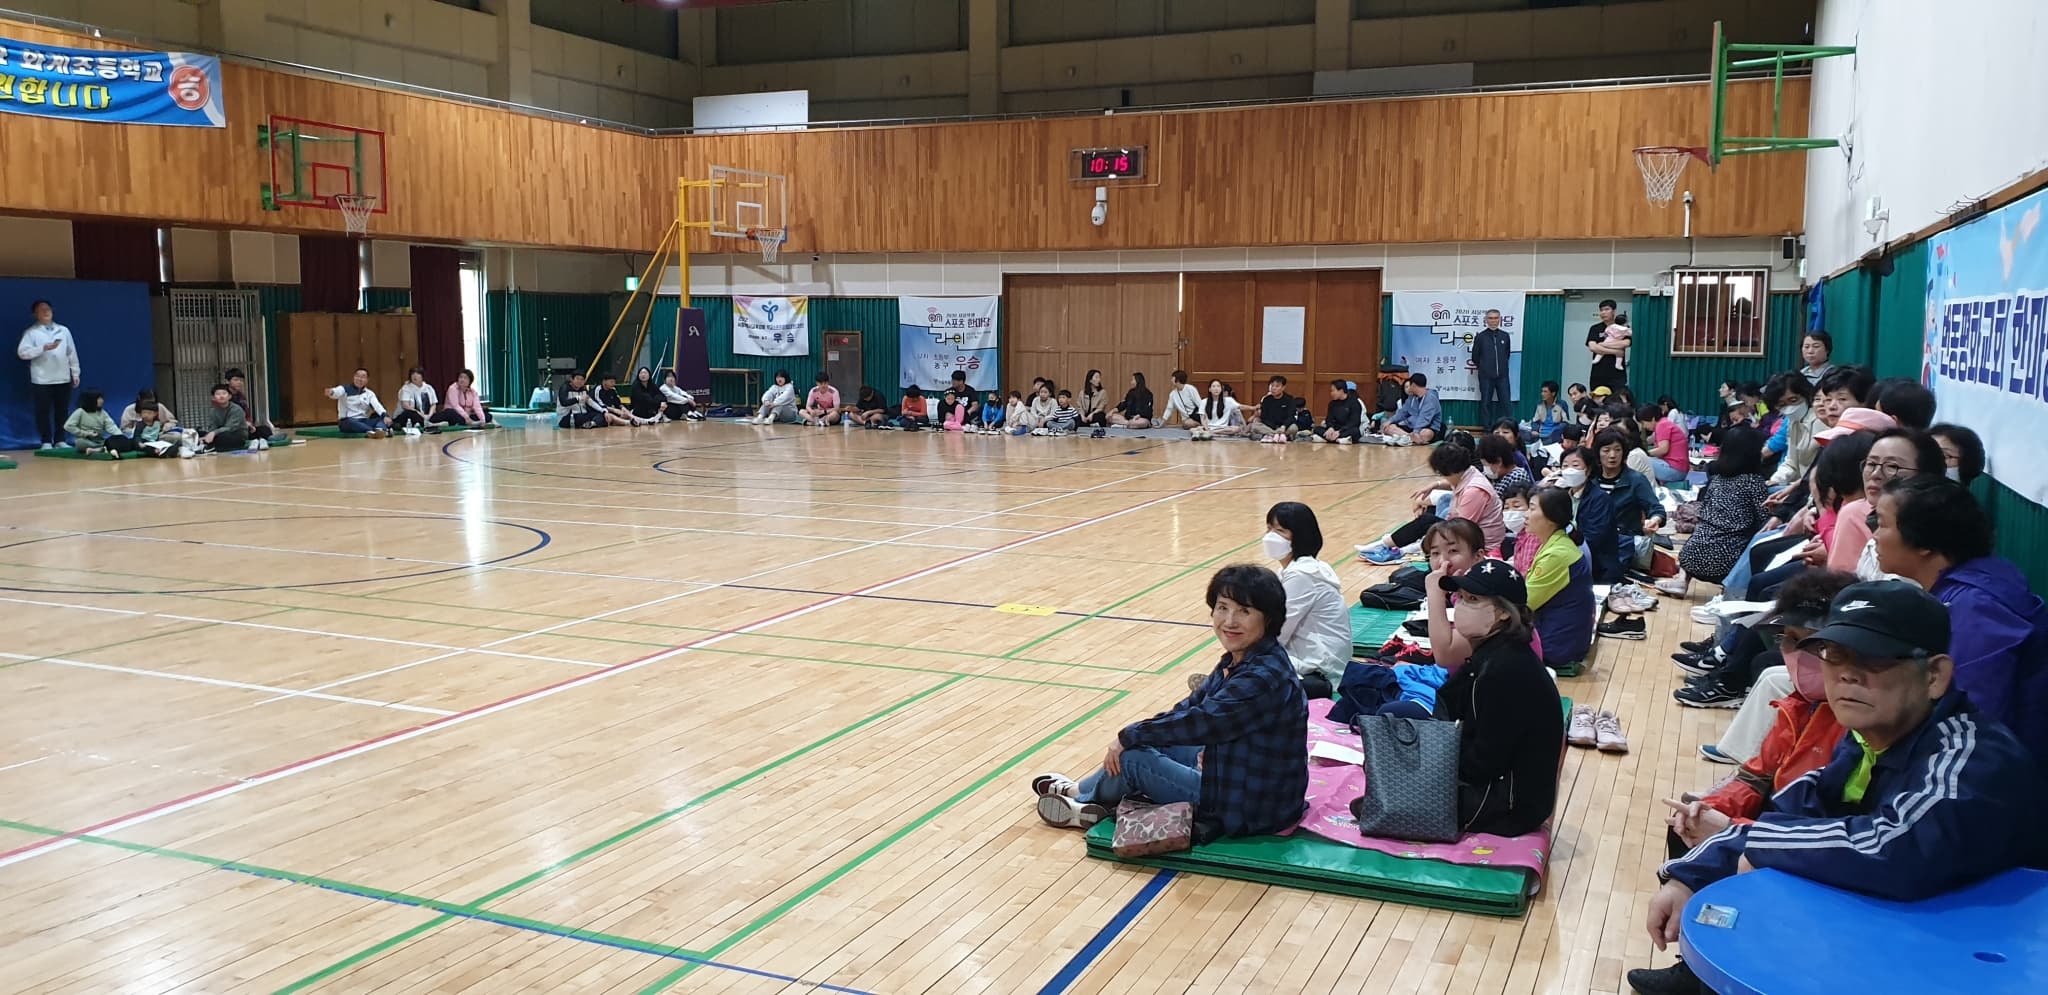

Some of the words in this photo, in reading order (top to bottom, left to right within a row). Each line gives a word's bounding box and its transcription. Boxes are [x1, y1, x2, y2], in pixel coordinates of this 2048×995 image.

[176, 73, 201, 101] 승
[1090, 157, 1129, 173] 10:15
[945, 318, 965, 328] 스포츠
[967, 317, 990, 328] 한마당
[1453, 315, 1480, 327] 스포츠
[773, 332, 795, 343] 우승
[2009, 294, 2048, 404] 한마
[954, 355, 980, 371] 우승
